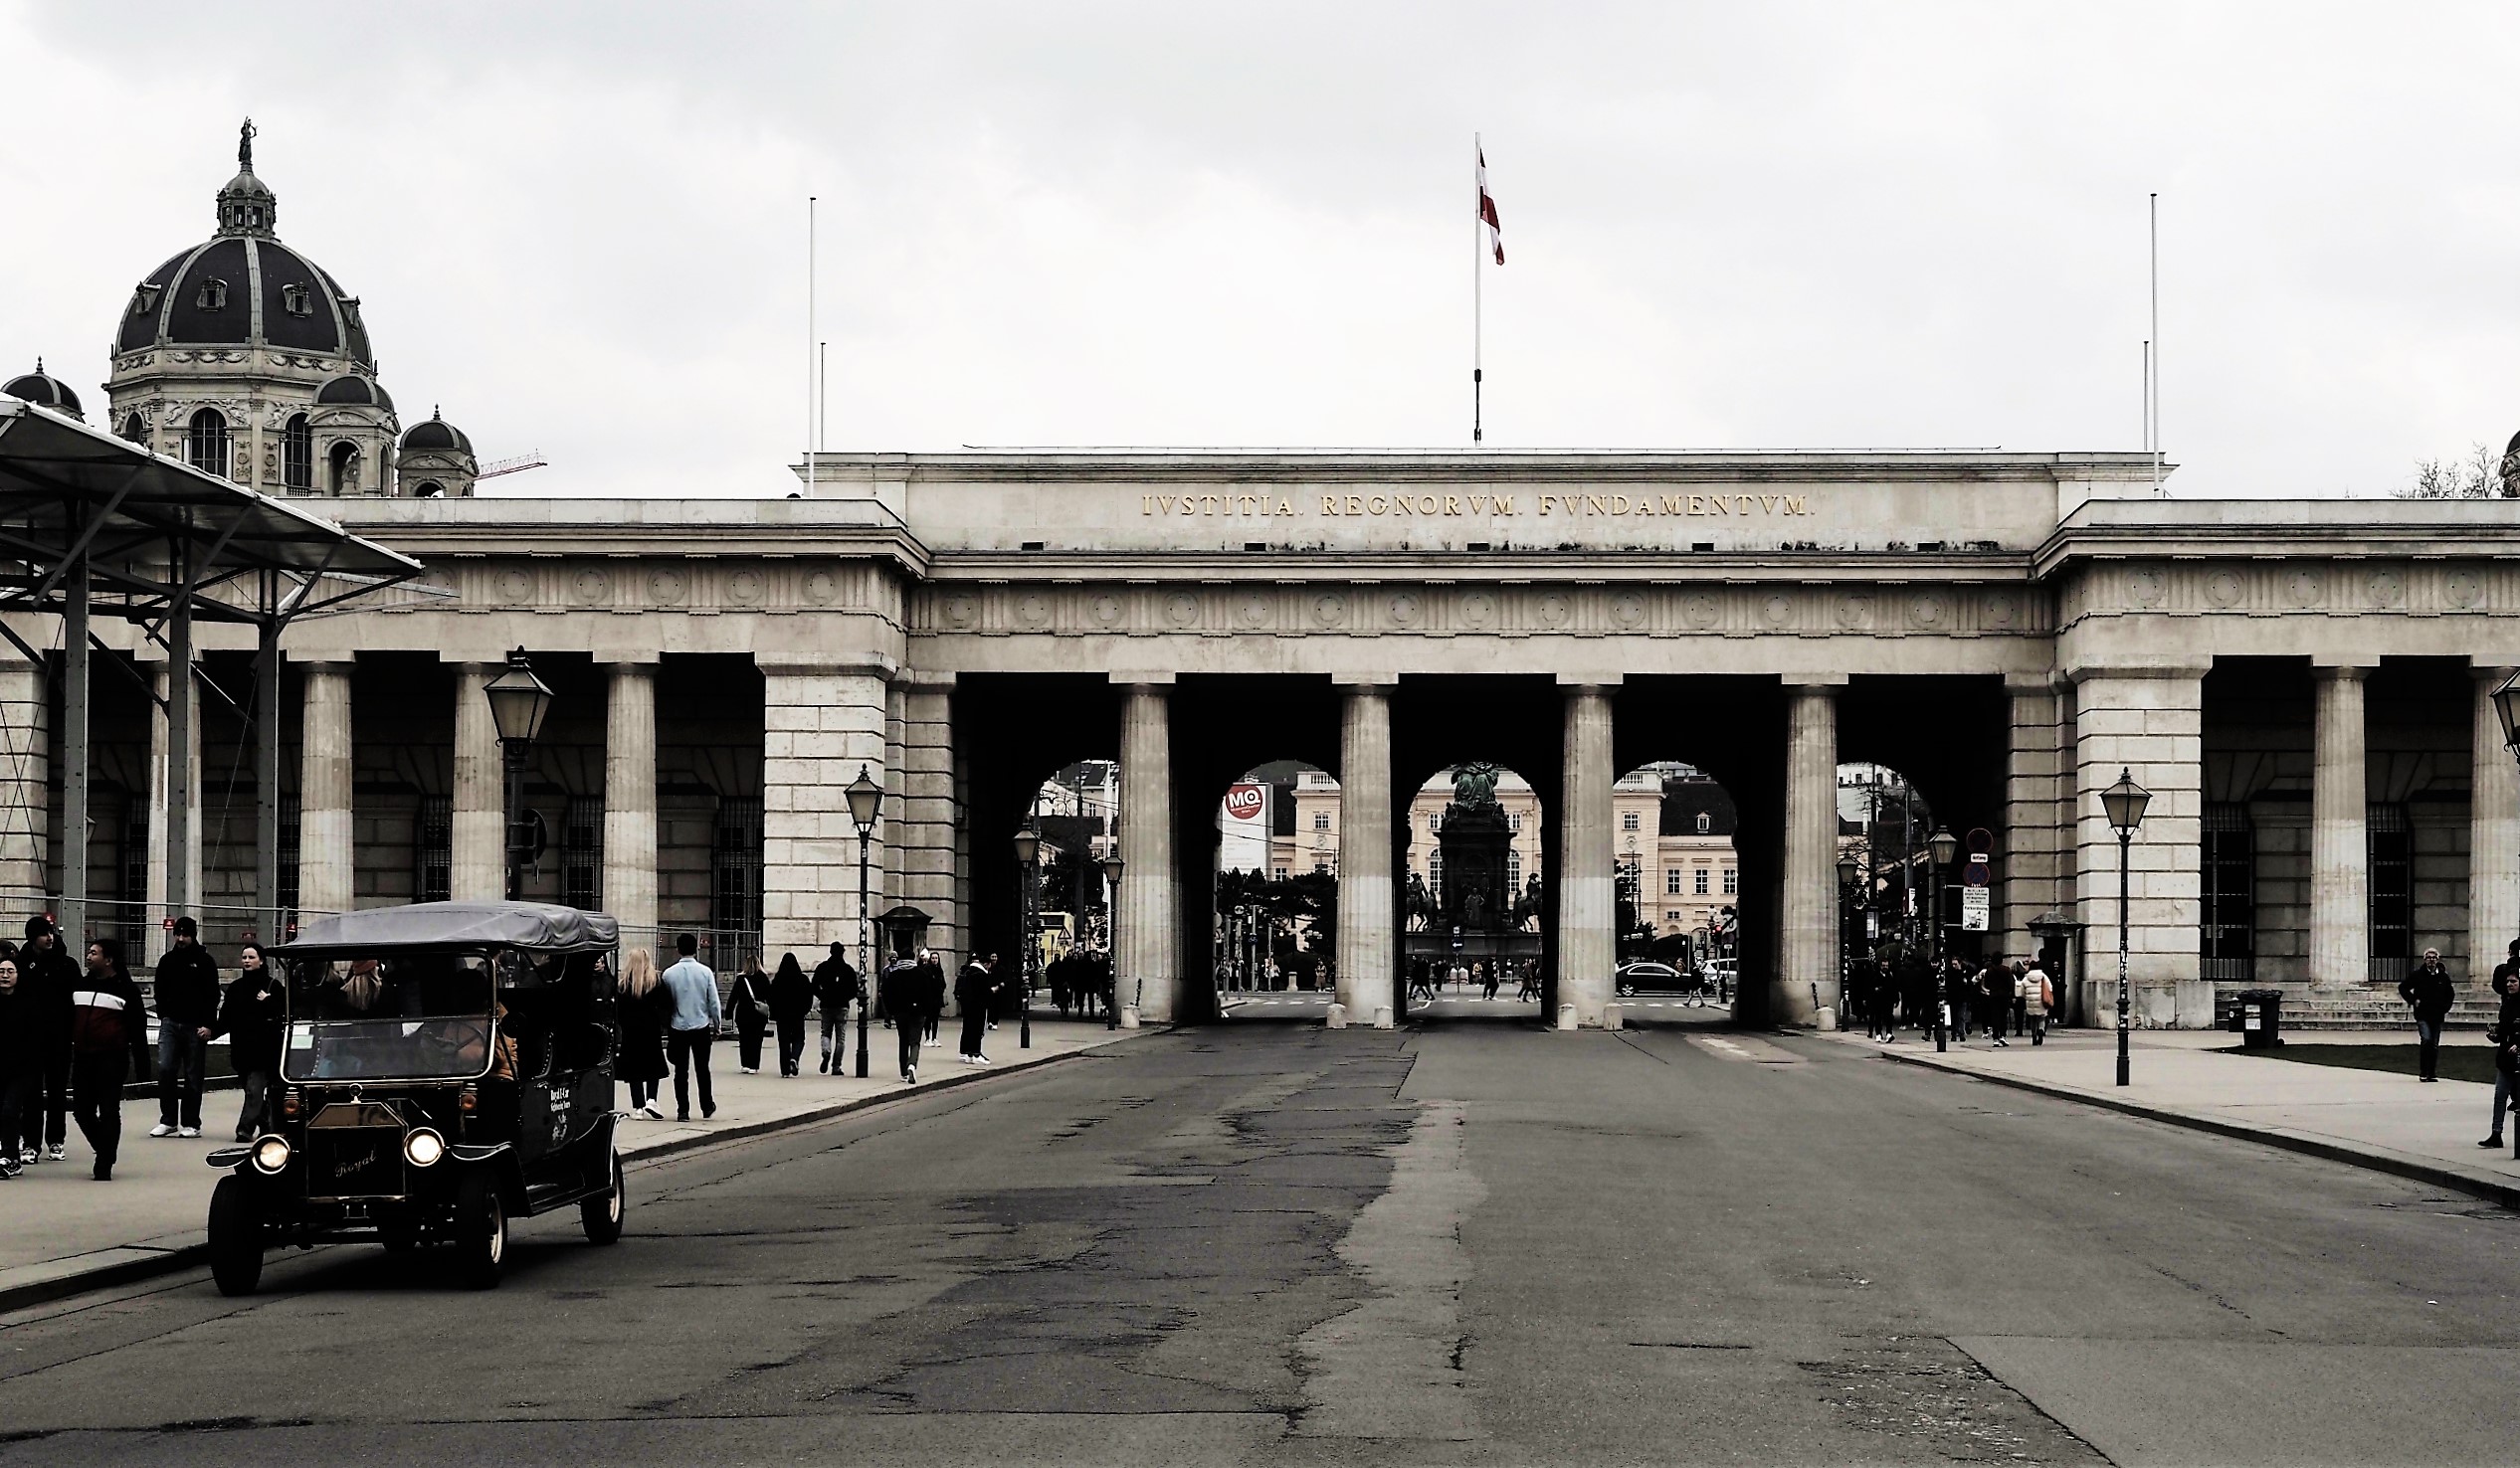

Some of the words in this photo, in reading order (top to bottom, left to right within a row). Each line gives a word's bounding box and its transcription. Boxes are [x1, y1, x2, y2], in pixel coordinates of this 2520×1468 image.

[1142, 495, 1305, 516] IVSTITIA.
[1321, 495, 1524, 516] REGNORVM.
[1538, 494, 1816, 515] FVNDAMENTVM.
[1228, 789, 1260, 808] MQ
[335, 1150, 377, 1178] Royal
